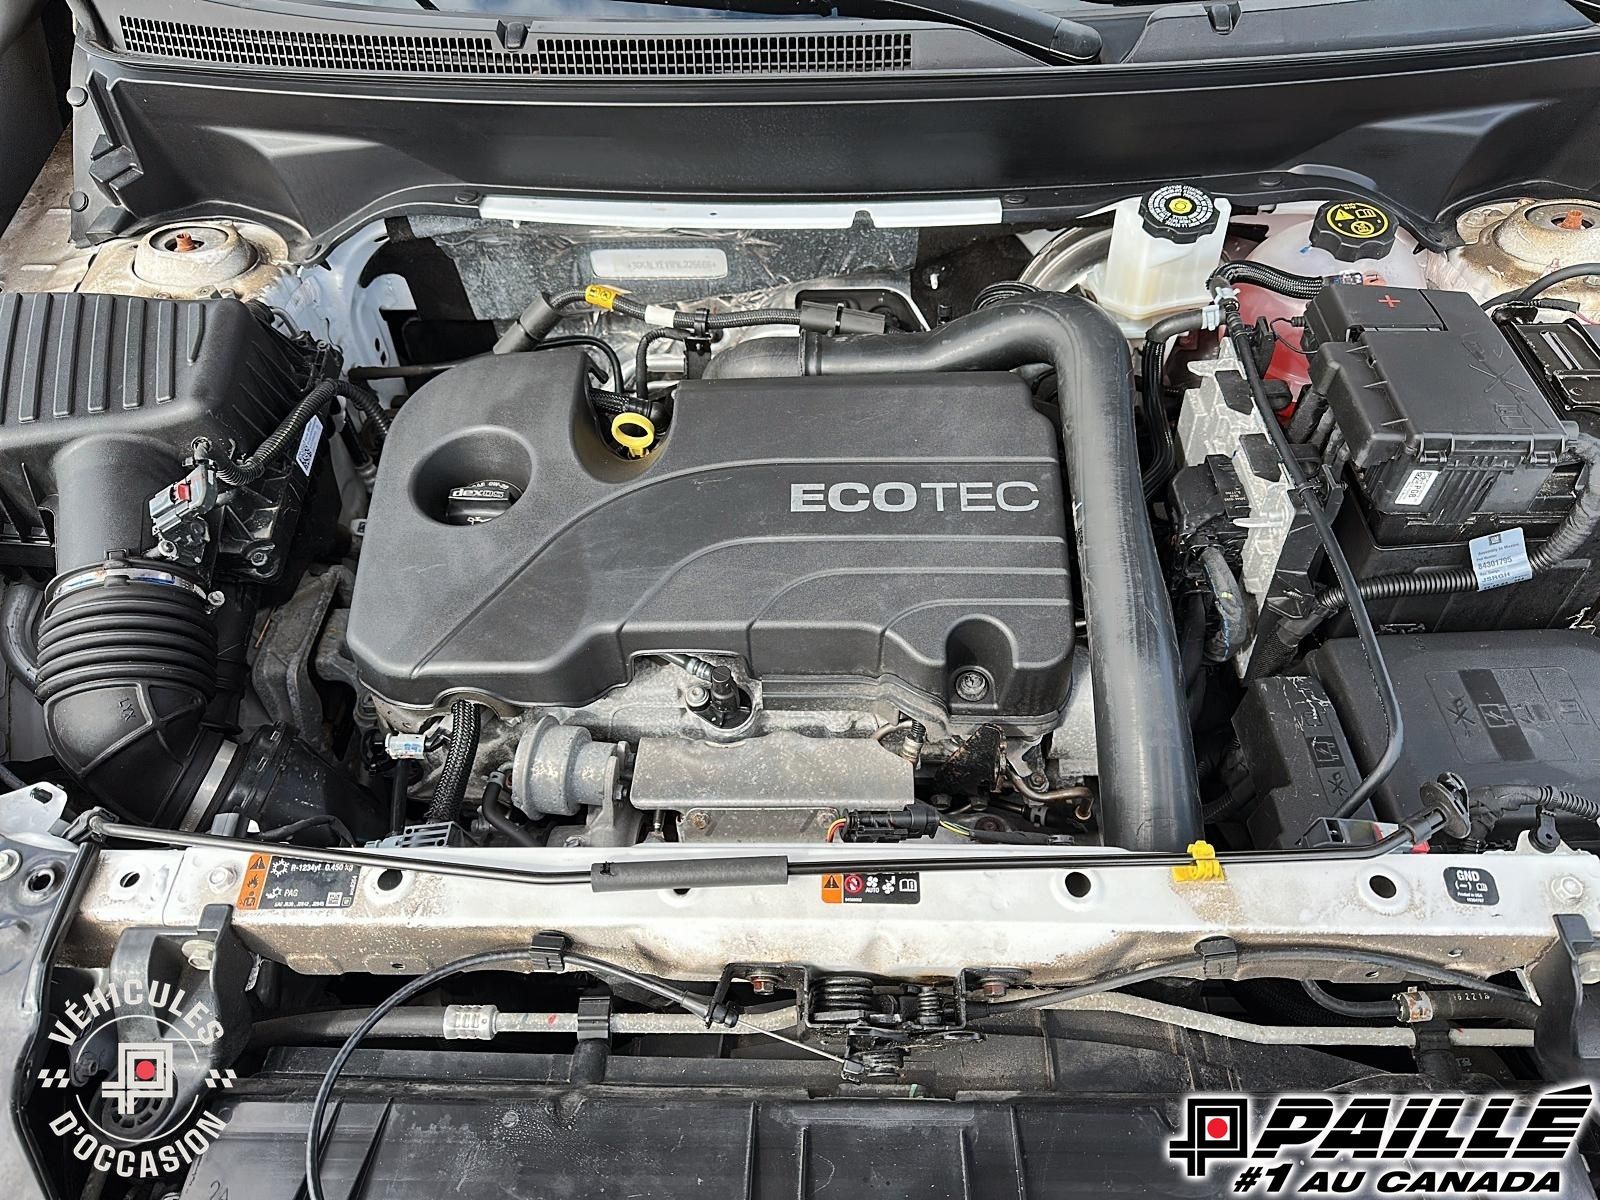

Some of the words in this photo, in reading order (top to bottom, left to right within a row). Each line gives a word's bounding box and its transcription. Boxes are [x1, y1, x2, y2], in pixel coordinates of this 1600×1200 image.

[452, 489, 505, 498] dexos
[790, 481, 1040, 513] ECOTEC
[324, 864, 343, 872] 0.450
[1456, 869, 1480, 882] GND
[283, 889, 299, 897] PAG
